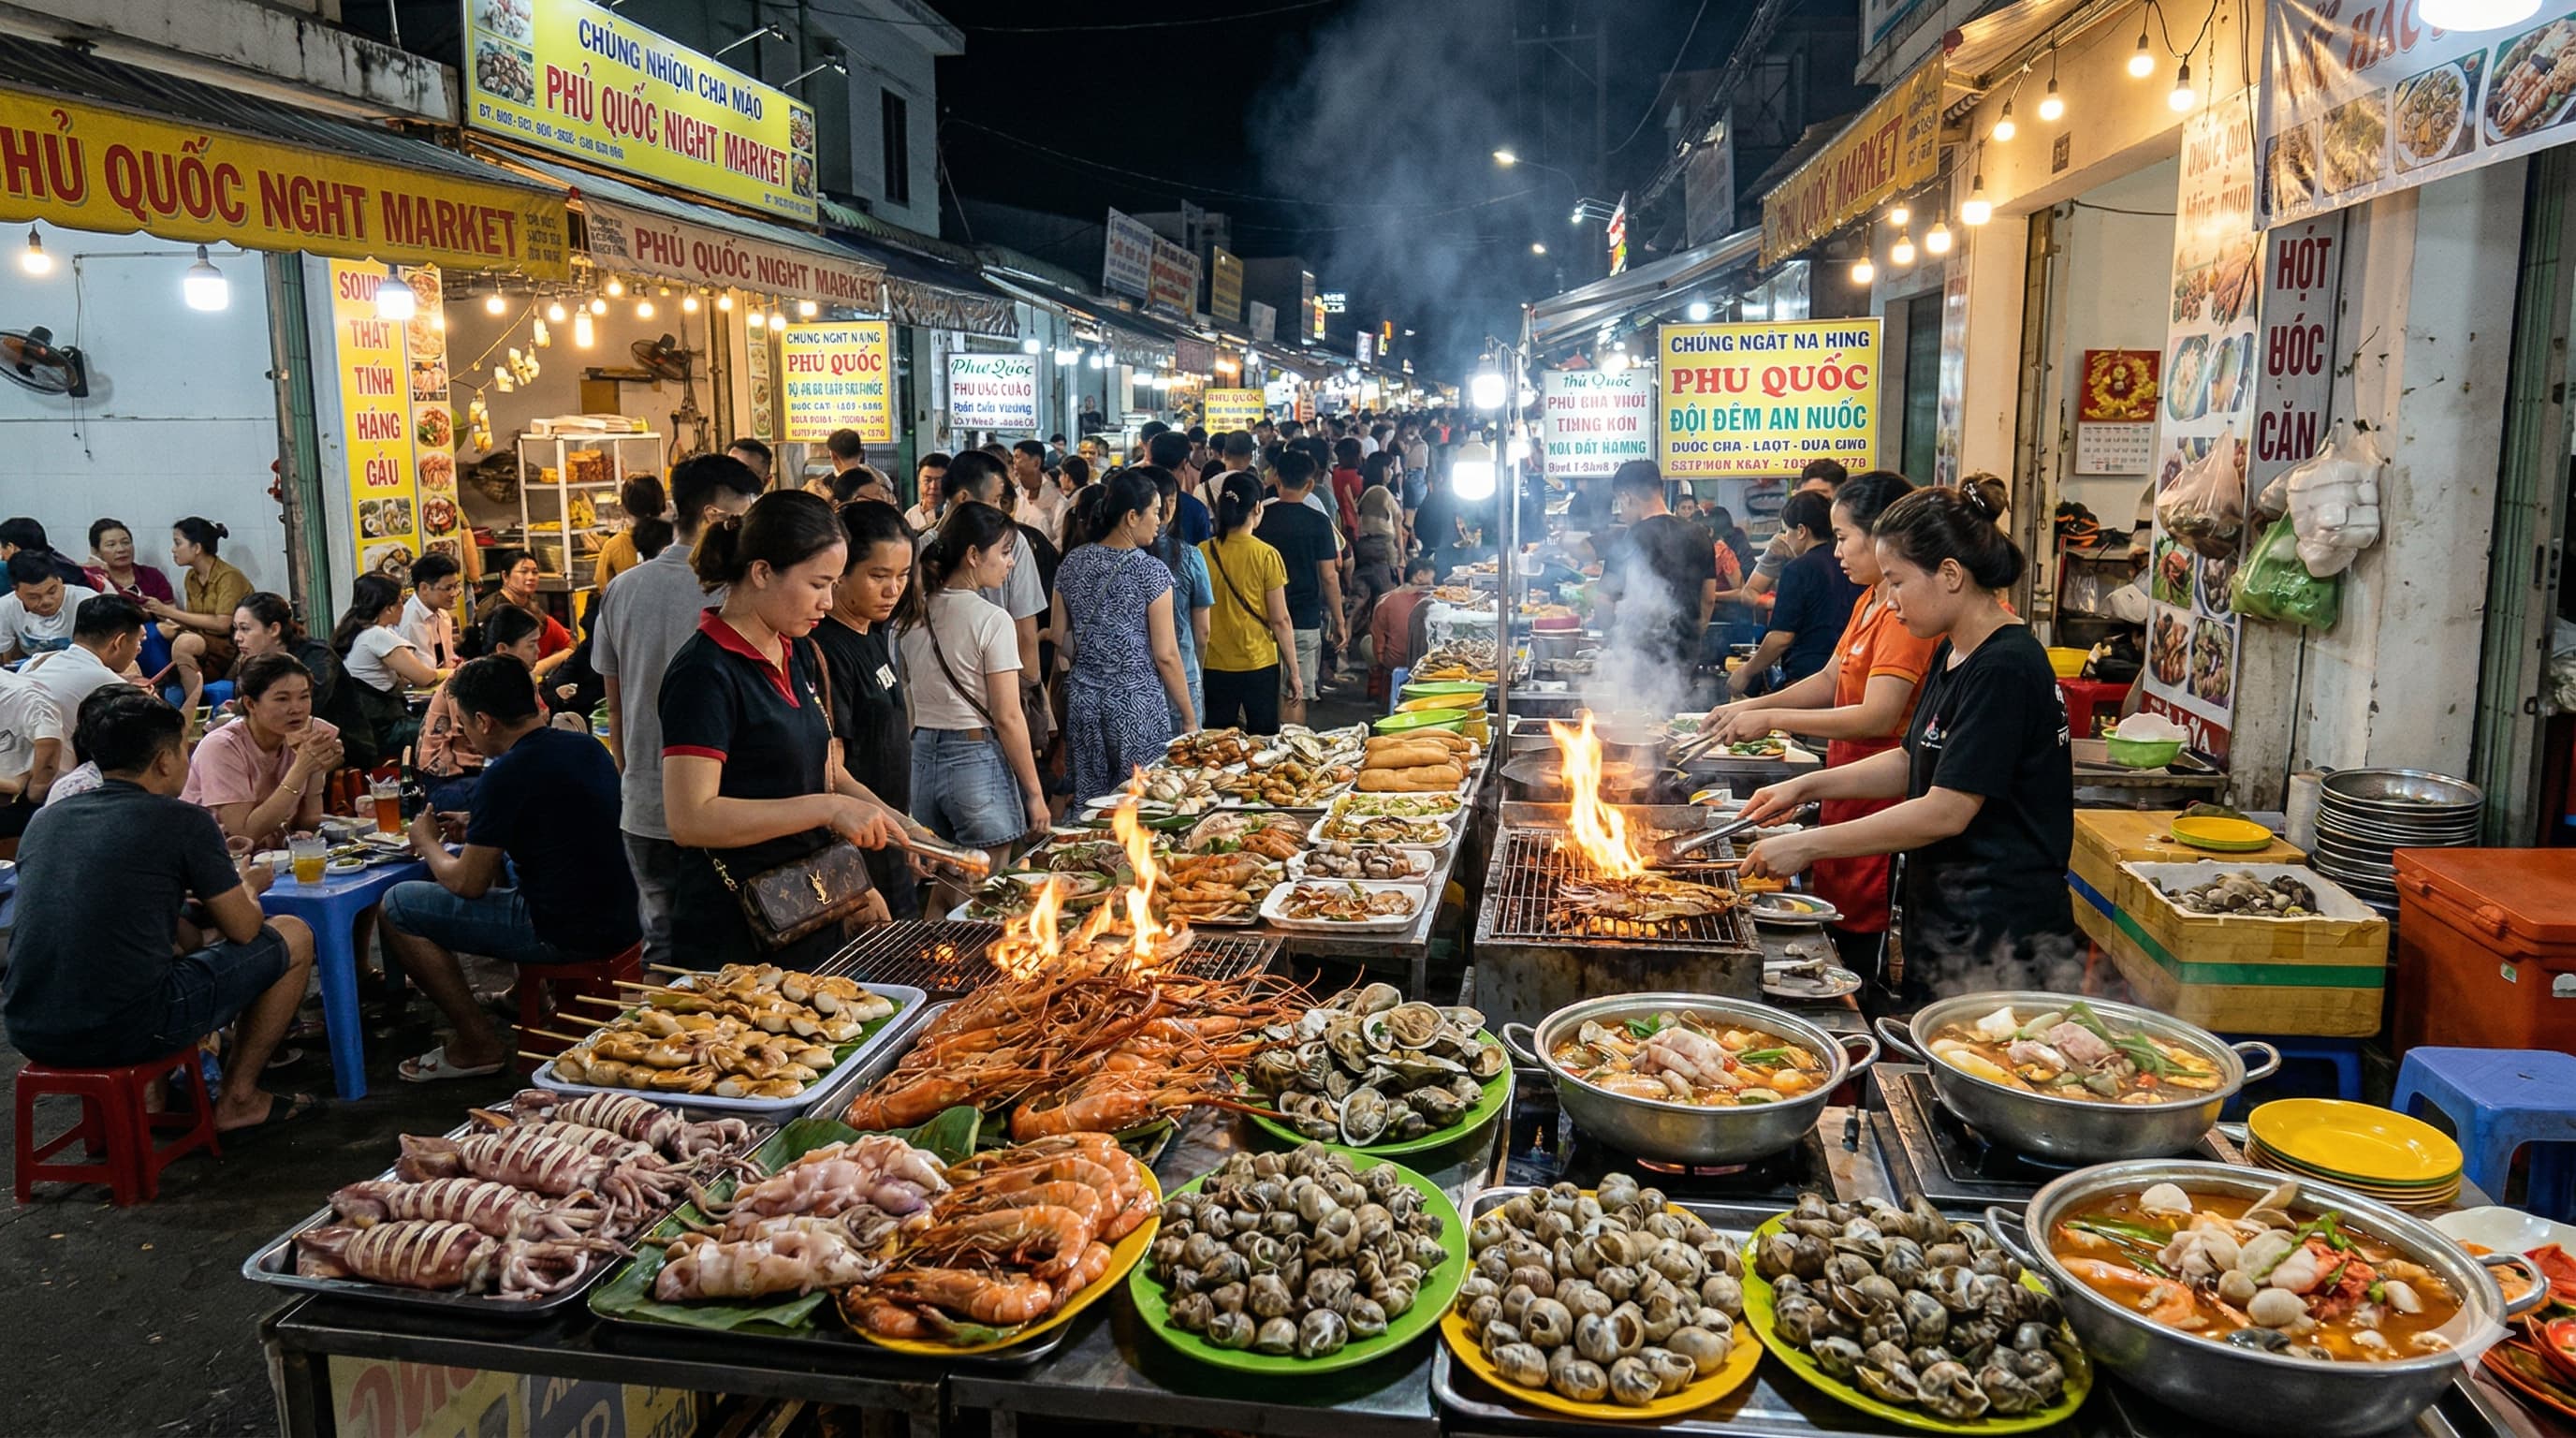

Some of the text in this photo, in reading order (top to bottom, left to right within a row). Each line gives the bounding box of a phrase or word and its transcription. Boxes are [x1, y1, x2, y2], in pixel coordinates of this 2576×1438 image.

[699, 73, 727, 107] CHA
[547, 62, 787, 187] PHỦ QUỐC NIGHT MARKET
[0, 109, 84, 202] HỦ
[104, 136, 245, 223] QUỐC
[257, 169, 366, 239] NGHT
[380, 190, 517, 258] MARKET
[635, 226, 684, 268] PHỦ
[693, 238, 751, 279] QUỐC
[756, 255, 809, 290] NIGHT
[814, 267, 878, 303] MARKET
[831, 345, 882, 375] QUỐC
[1671, 331, 1734, 353] CHÚNG
[1793, 333, 1819, 349] NA
[1671, 352, 1868, 398] PHU QUỐC
[1670, 403, 1705, 436] ĐỘI
[1768, 407, 1799, 430] AN
[2258, 400, 2317, 462] CĂN
[1801, 439, 1831, 450] DUA
